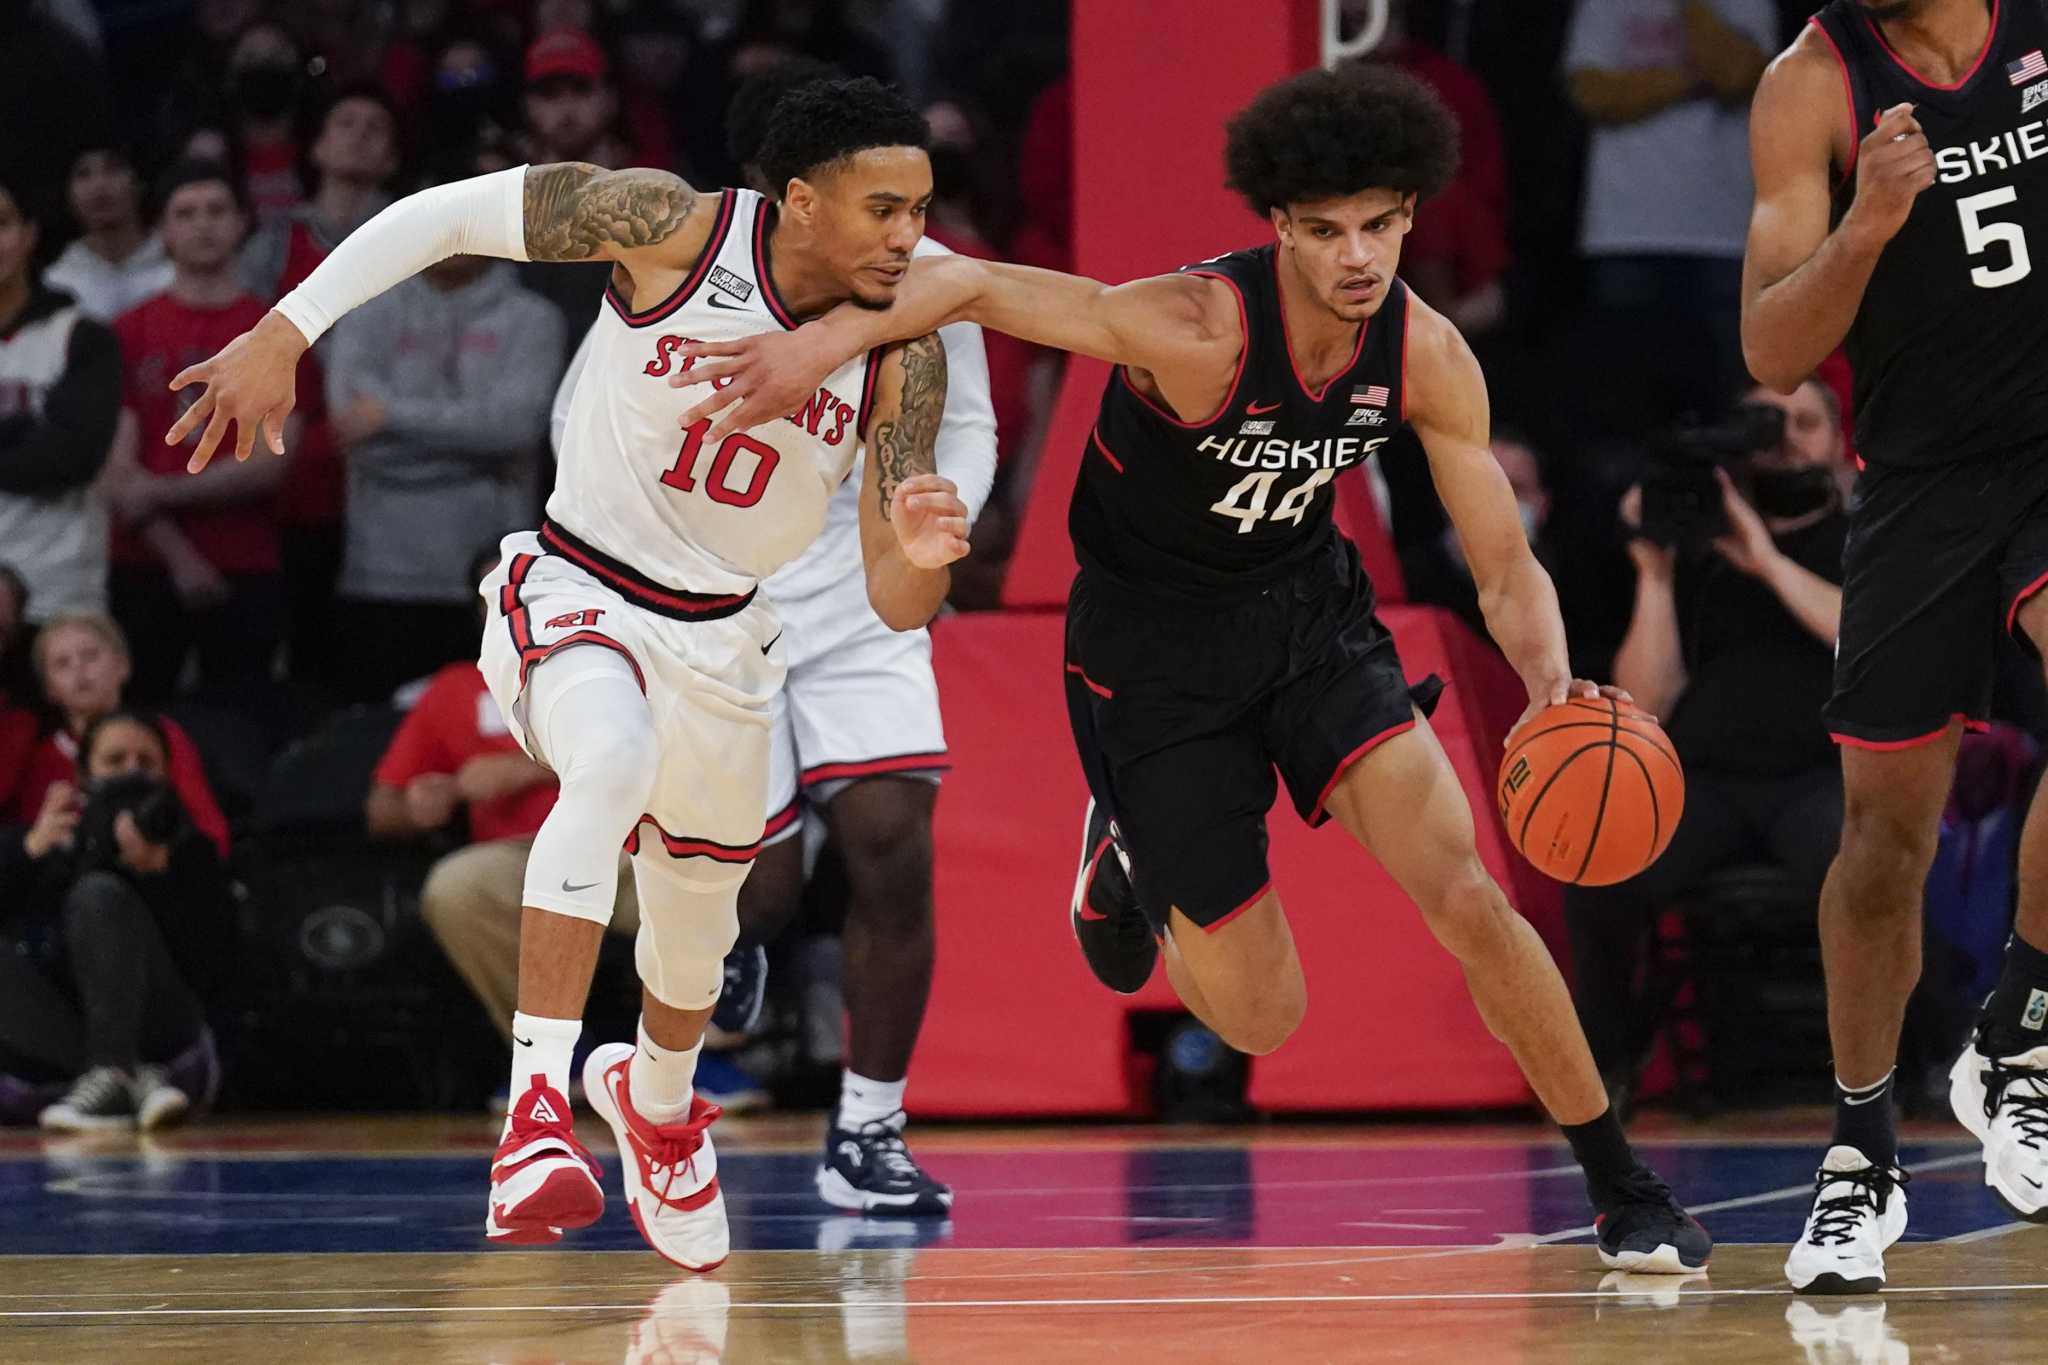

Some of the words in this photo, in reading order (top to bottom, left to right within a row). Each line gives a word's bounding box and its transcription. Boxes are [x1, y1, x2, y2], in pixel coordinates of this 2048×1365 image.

[1935, 119, 2048, 183] SKIE
[1956, 186, 2031, 288] 5
[1347, 415, 1388, 425] EAST
[1353, 408, 1381, 417] BIG
[660, 417, 780, 508] 10
[1210, 467, 1336, 533] 44
